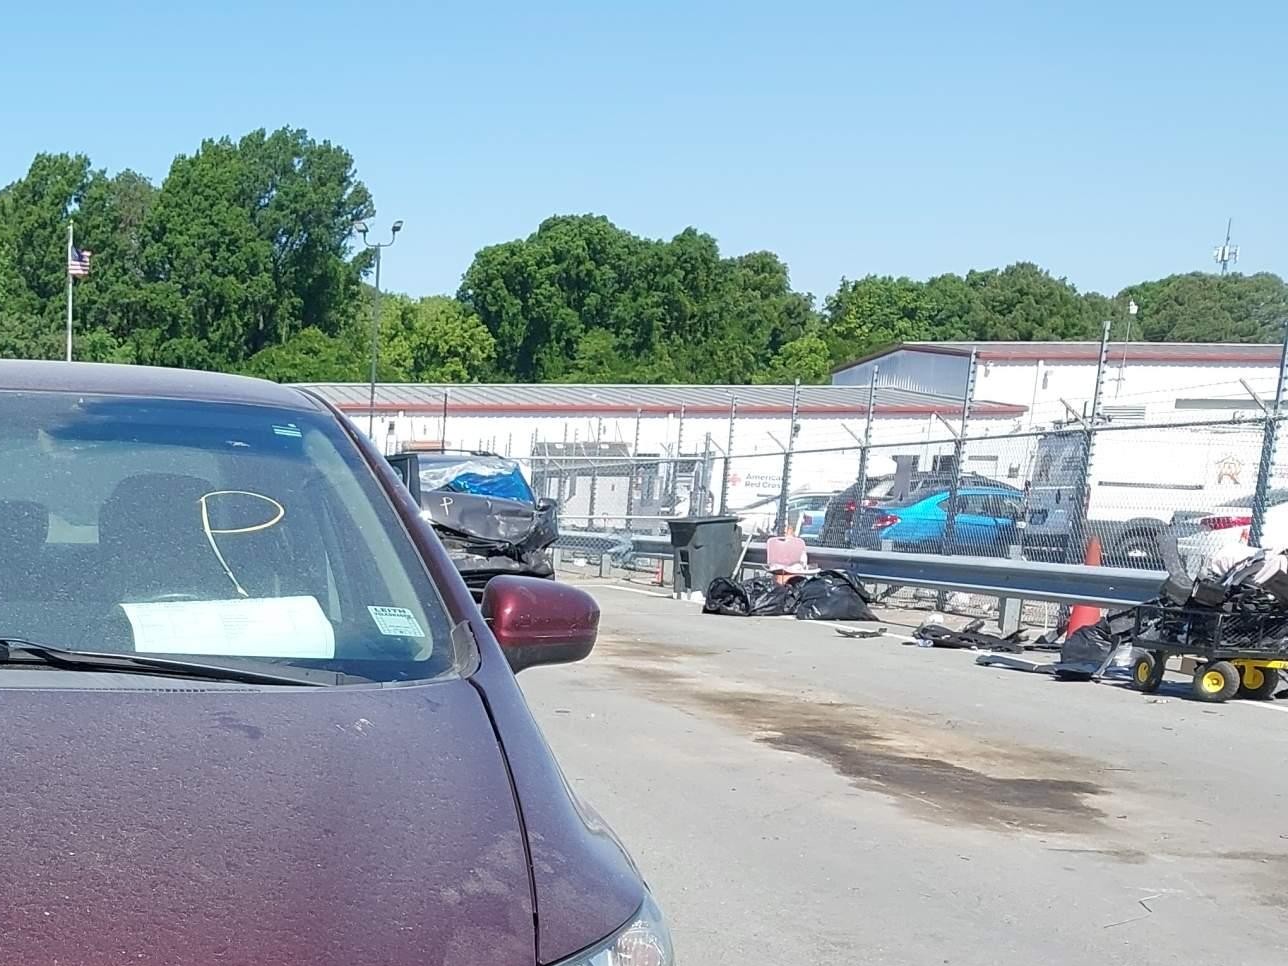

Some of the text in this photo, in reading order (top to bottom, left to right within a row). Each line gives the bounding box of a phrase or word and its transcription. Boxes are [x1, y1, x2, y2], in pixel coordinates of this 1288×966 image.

[746, 473, 781, 481] America
[745, 480, 781, 489] Red Cros
[196, 490, 285, 598] P
